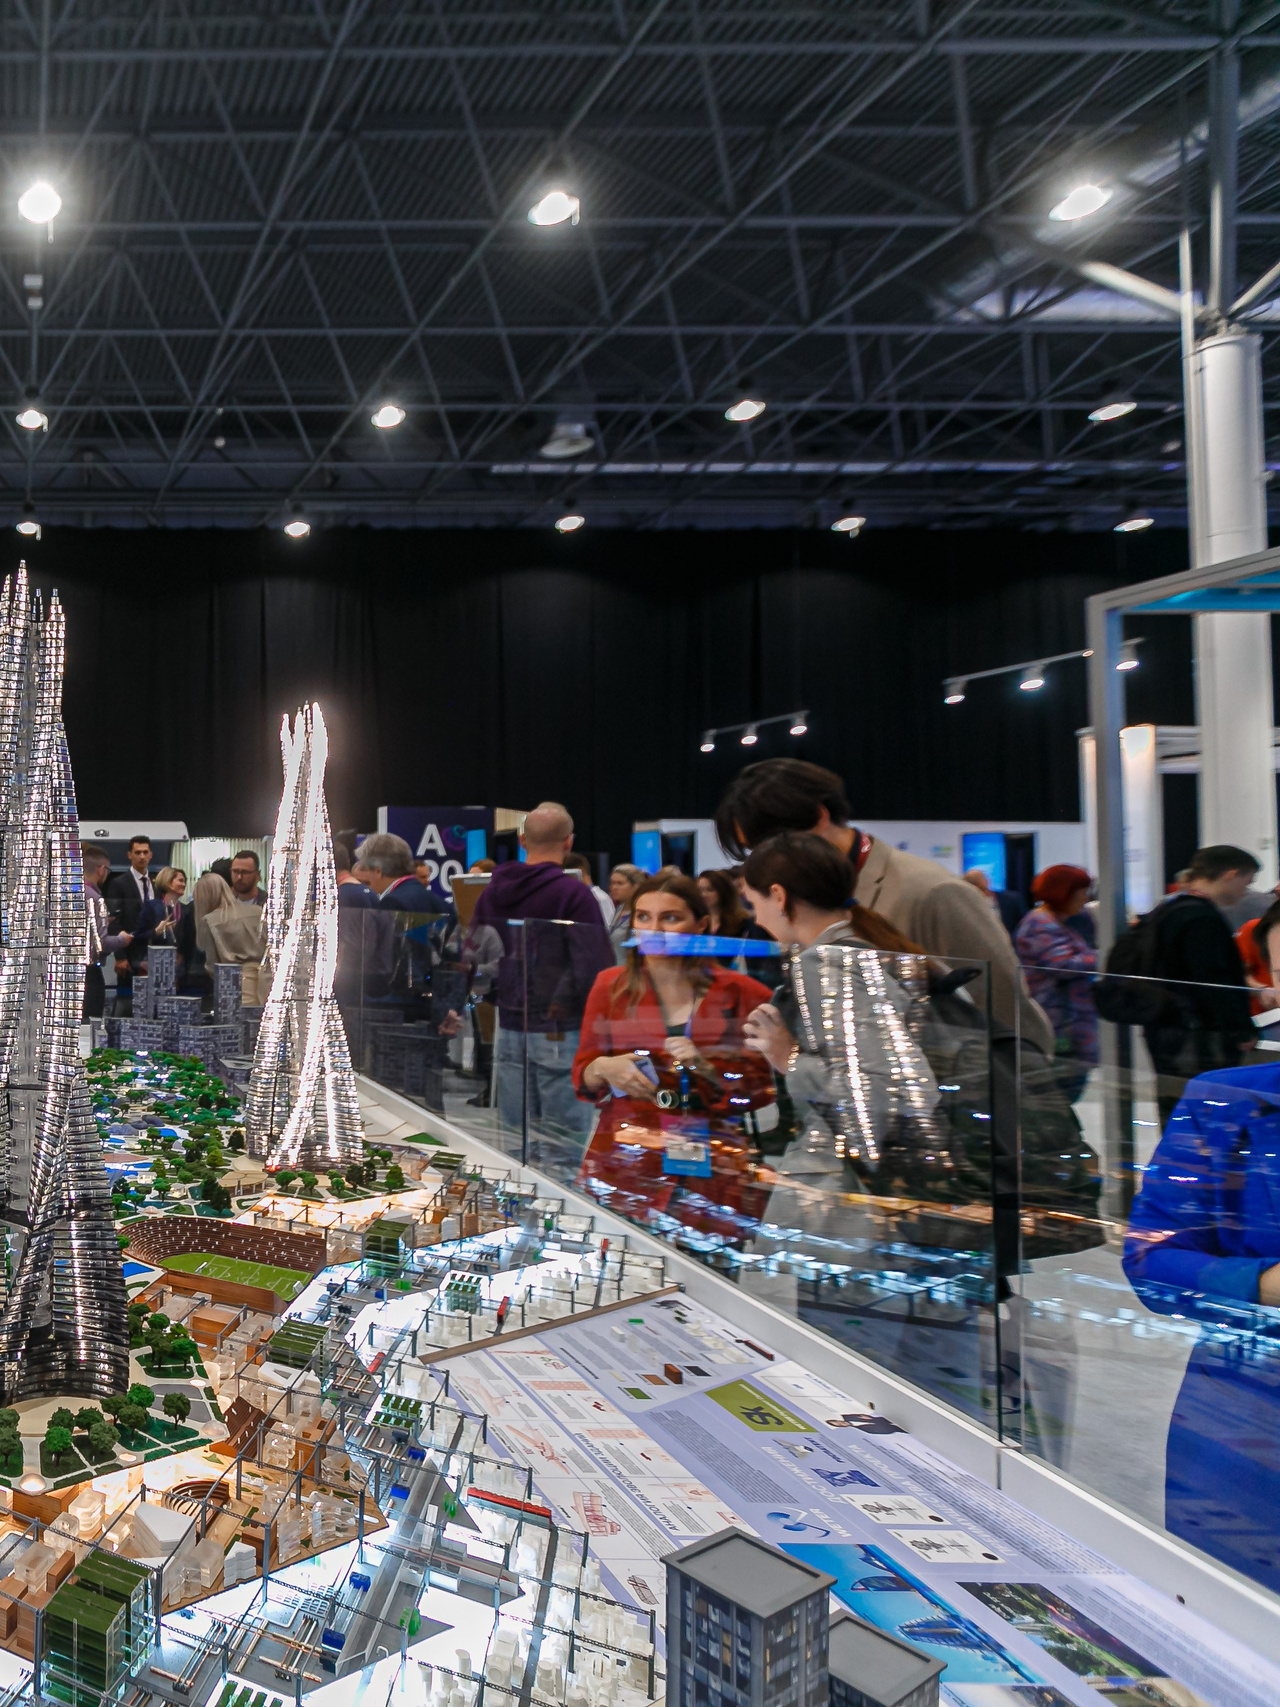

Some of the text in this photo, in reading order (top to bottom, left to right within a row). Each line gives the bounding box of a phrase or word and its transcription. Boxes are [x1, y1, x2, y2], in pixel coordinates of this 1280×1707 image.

[573, 1432, 604, 1456] ЗДАНИЙ
[847, 1444, 904, 1481] ПРОЕКТА
[598, 1456, 641, 1492] ЭВОЛЮЦИИ
[761, 1446, 847, 1505] ДОСТИЖЕНИЯ
[635, 1493, 680, 1531] АНАЛОГИЯ
[809, 1508, 852, 1538] WETER
[901, 1481, 1019, 1557] ПРЕИМУЩЕСТВА
